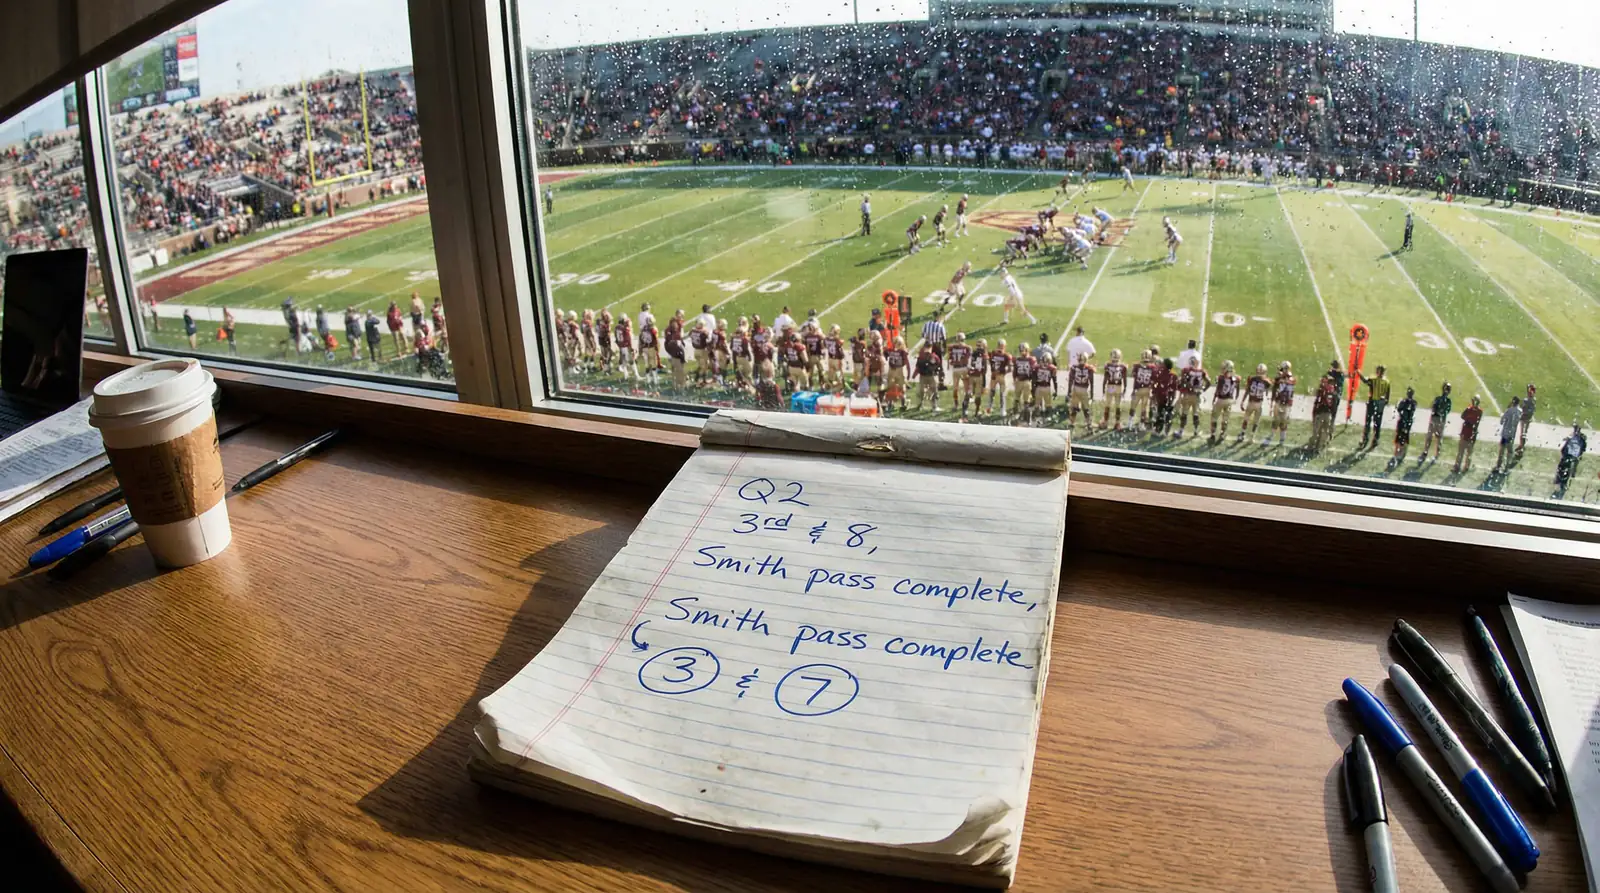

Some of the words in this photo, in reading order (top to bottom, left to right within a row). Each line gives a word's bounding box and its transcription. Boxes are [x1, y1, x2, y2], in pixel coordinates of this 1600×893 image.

[738, 477, 810, 507] Q2
[732, 513, 793, 534] 3rd
[846, 523, 879, 554] 8,
[693, 546, 787, 580] Smith
[804, 568, 876, 593] pass
[893, 577, 1037, 612] complete,
[664, 597, 770, 636] Smith
[790, 624, 868, 655] pass
[884, 636, 1034, 670] complete
[662, 656, 697, 683] 3
[800, 675, 832, 706] 7
